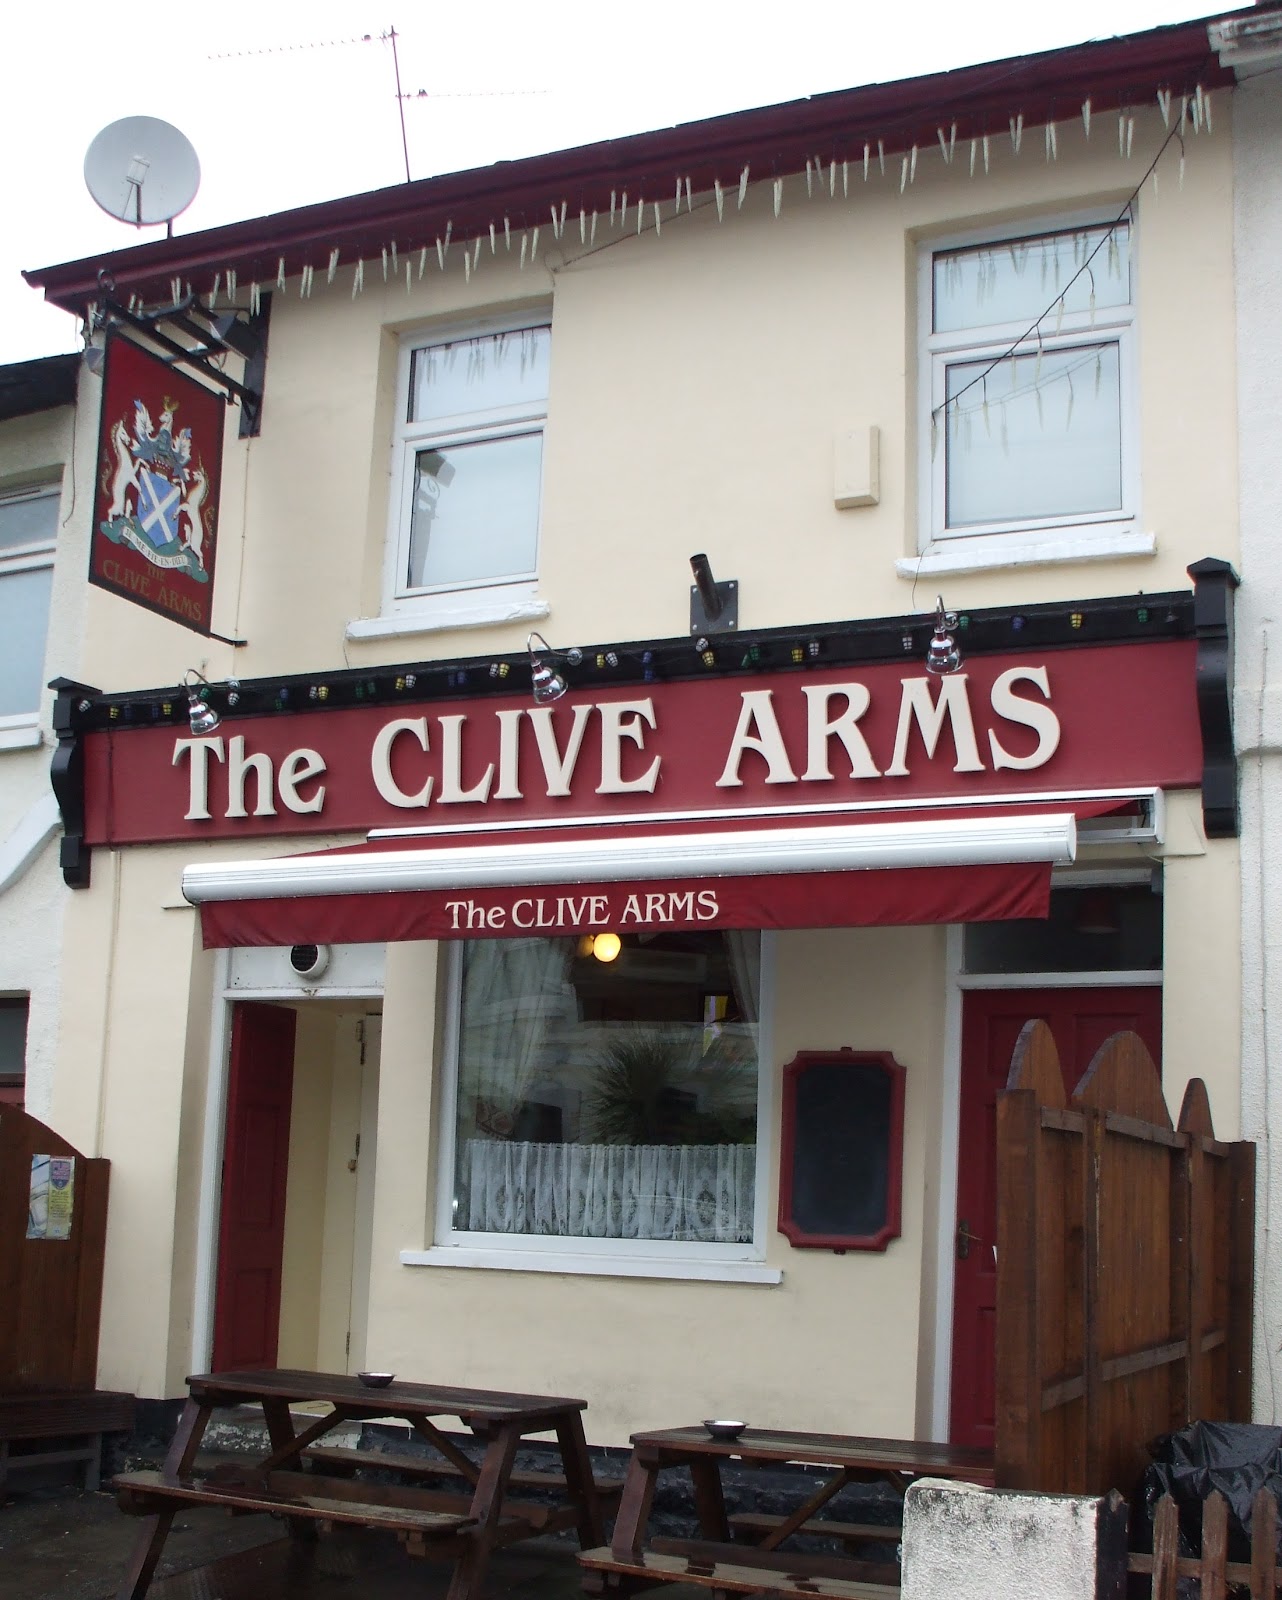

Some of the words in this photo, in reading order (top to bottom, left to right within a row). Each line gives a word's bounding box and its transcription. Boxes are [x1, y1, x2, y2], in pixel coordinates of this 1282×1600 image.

[102, 559, 149, 597] CLIVE
[157, 586, 202, 621] ARMS
[171, 734, 327, 821] The
[371, 697, 662, 809] CLIVE
[714, 665, 1061, 788] ARMS
[445, 900, 506, 930] The
[511, 895, 612, 929] CLIVE
[620, 890, 720, 924] ARMS
